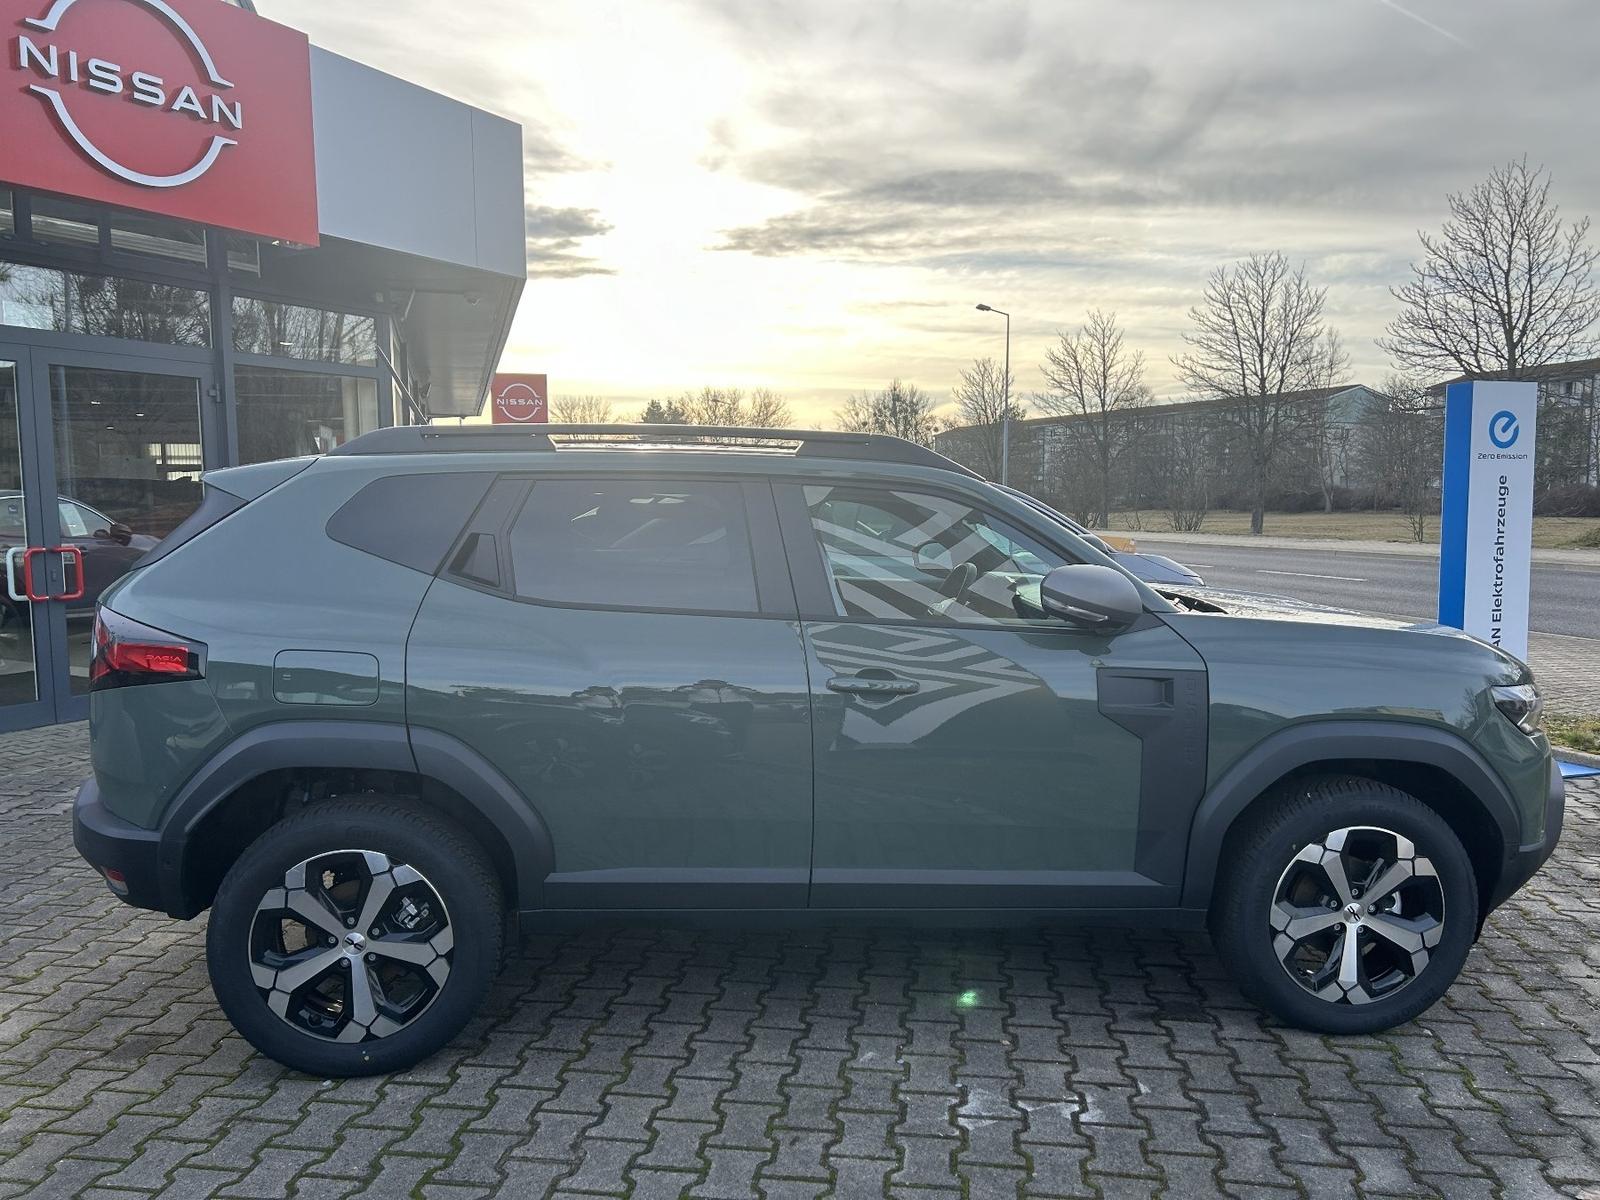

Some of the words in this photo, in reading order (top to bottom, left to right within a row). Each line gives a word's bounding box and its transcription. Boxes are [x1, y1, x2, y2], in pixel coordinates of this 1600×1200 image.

[18, 34, 243, 129] NISSAN
[496, 398, 543, 406] NISSAN
[1491, 475, 1510, 622] Elektrofahrzeuge
